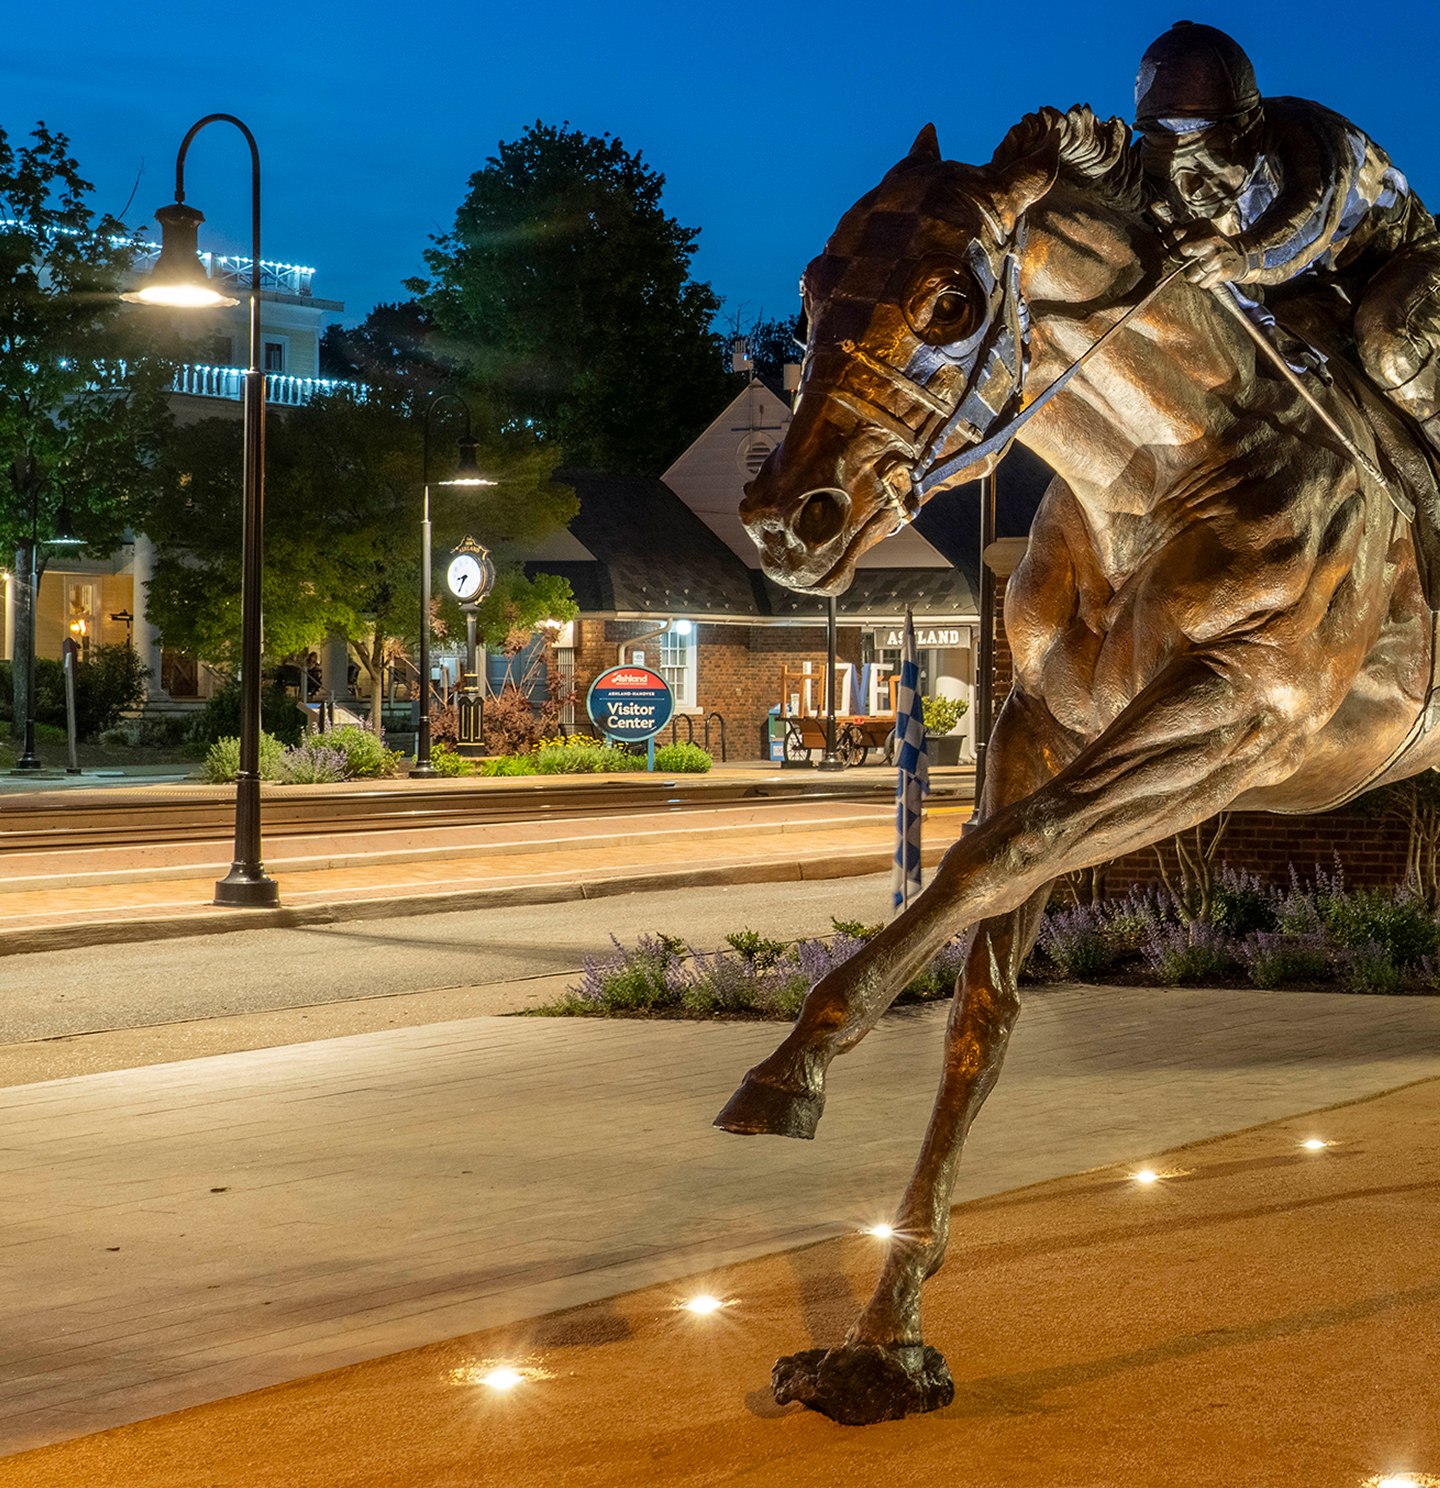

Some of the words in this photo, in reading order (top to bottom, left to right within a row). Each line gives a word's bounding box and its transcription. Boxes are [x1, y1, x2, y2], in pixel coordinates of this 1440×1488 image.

[887, 630, 959, 645] ASLAND
[611, 673, 648, 683] Ashland
[607, 702, 655, 715] Visitor
[607, 716, 655, 728] Center
